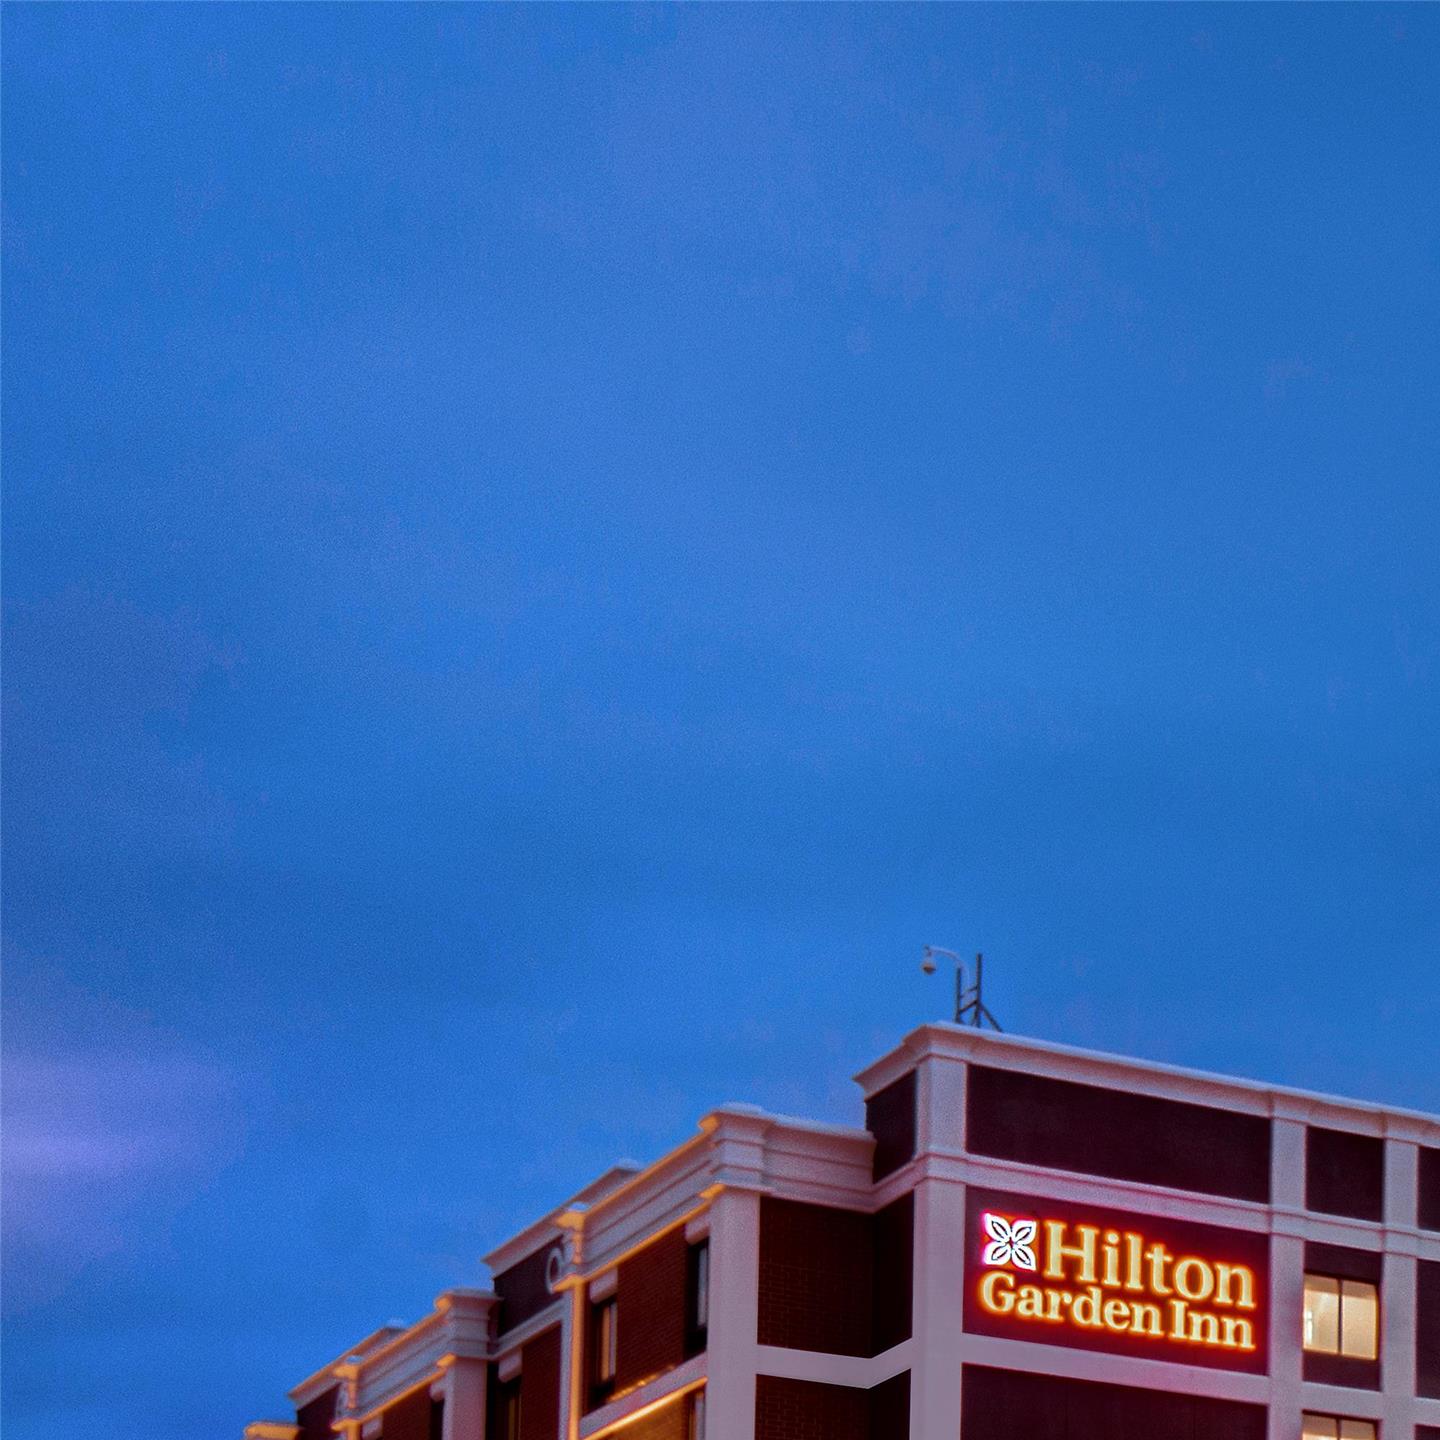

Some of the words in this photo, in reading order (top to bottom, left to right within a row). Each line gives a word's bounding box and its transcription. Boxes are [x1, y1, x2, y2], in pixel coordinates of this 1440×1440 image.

[1041, 1218, 1256, 1310] Hilton
[978, 1271, 1164, 1336] Garden
[1166, 1299, 1257, 1350] Inn
